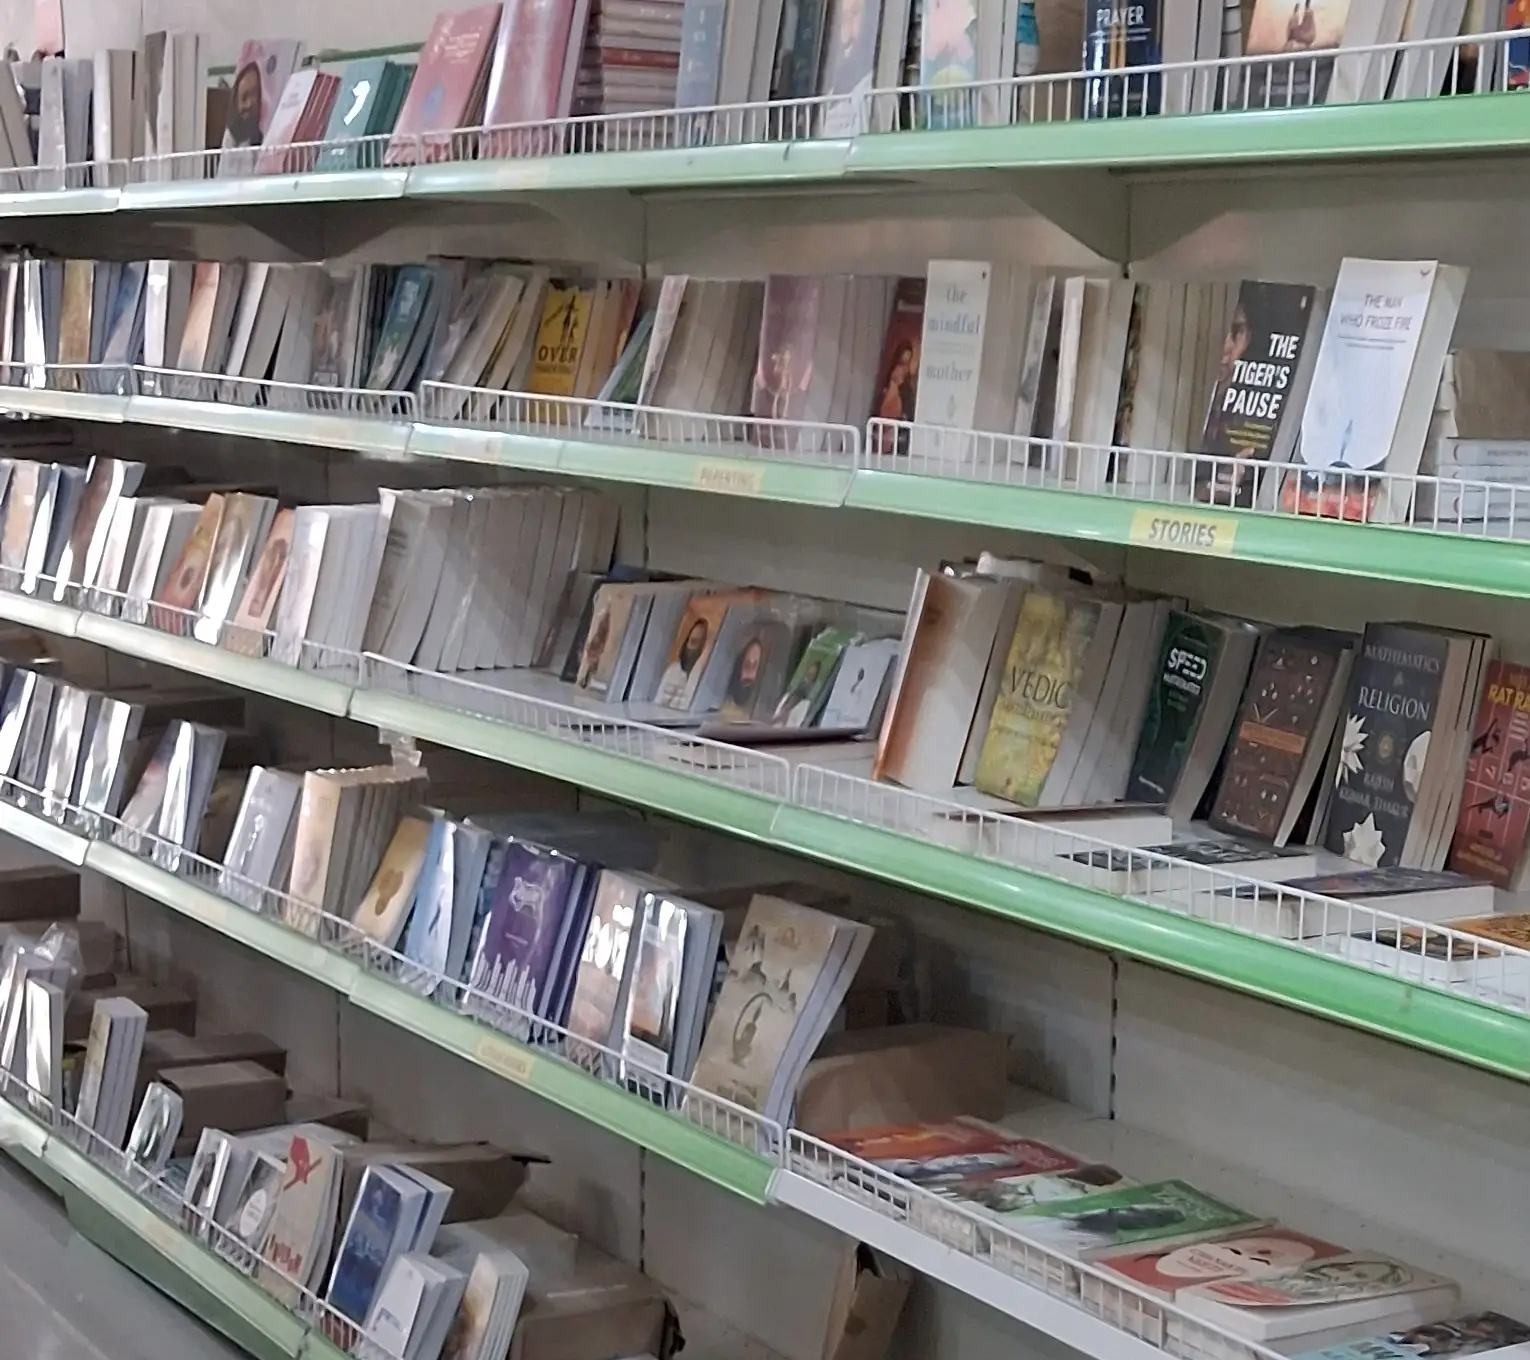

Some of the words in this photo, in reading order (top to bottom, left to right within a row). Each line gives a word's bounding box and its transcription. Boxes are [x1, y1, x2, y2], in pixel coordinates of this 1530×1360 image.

[1096, 5, 1144, 27] PRAYER
[1364, 293, 1384, 308] THE
[928, 312, 980, 335] mindful
[538, 344, 578, 363] OVER
[1270, 333, 1299, 360] THE
[1233, 360, 1290, 389] TIGER'S
[1222, 388, 1282, 420] PAUSE
[1149, 518, 1217, 548] STORIES
[1012, 665, 1072, 709] VEDIC
[1488, 683, 1515, 706] RAT
[1358, 685, 1431, 721] RELIGION
